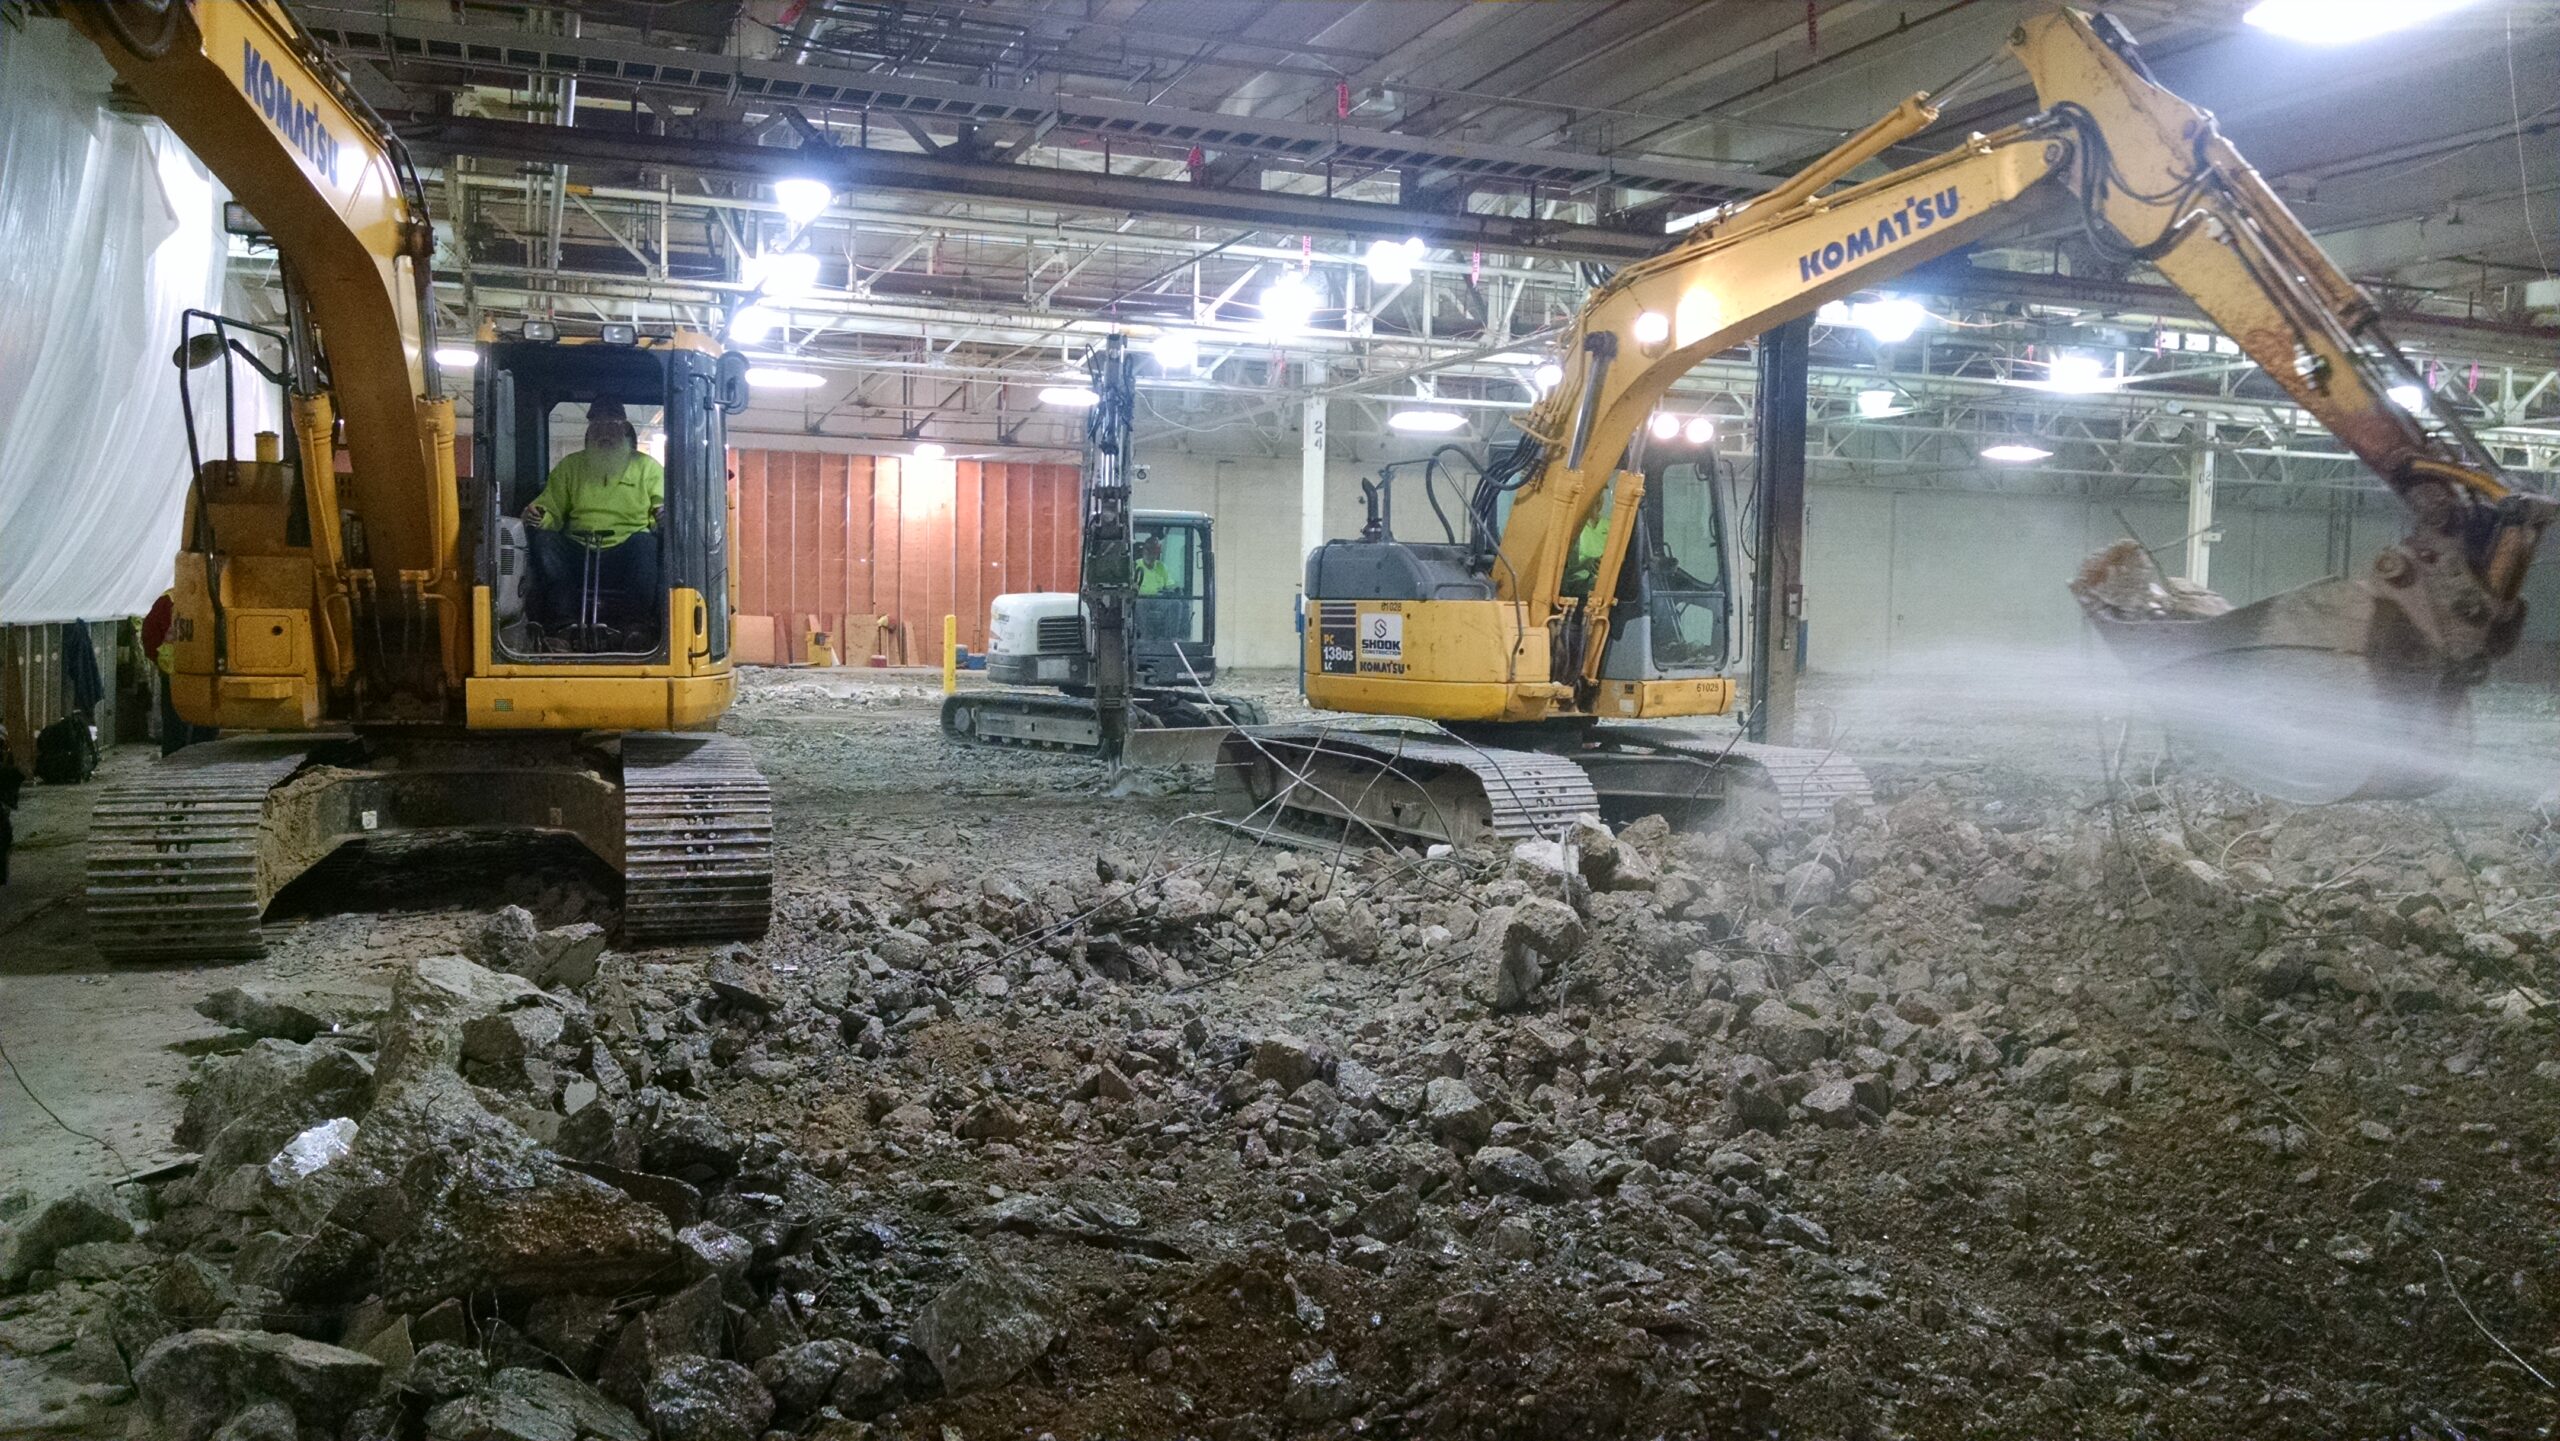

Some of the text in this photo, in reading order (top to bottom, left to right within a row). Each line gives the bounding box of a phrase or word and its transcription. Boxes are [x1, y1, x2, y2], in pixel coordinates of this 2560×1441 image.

[244, 37, 339, 188] KOMATSU
[1799, 185, 1959, 282] KOMATSU
[1323, 634, 1334, 645] PC
[1362, 639, 1400, 651] SHOOK
[1324, 661, 1333, 671] LC
[1360, 661, 1405, 674] KOMATSU
